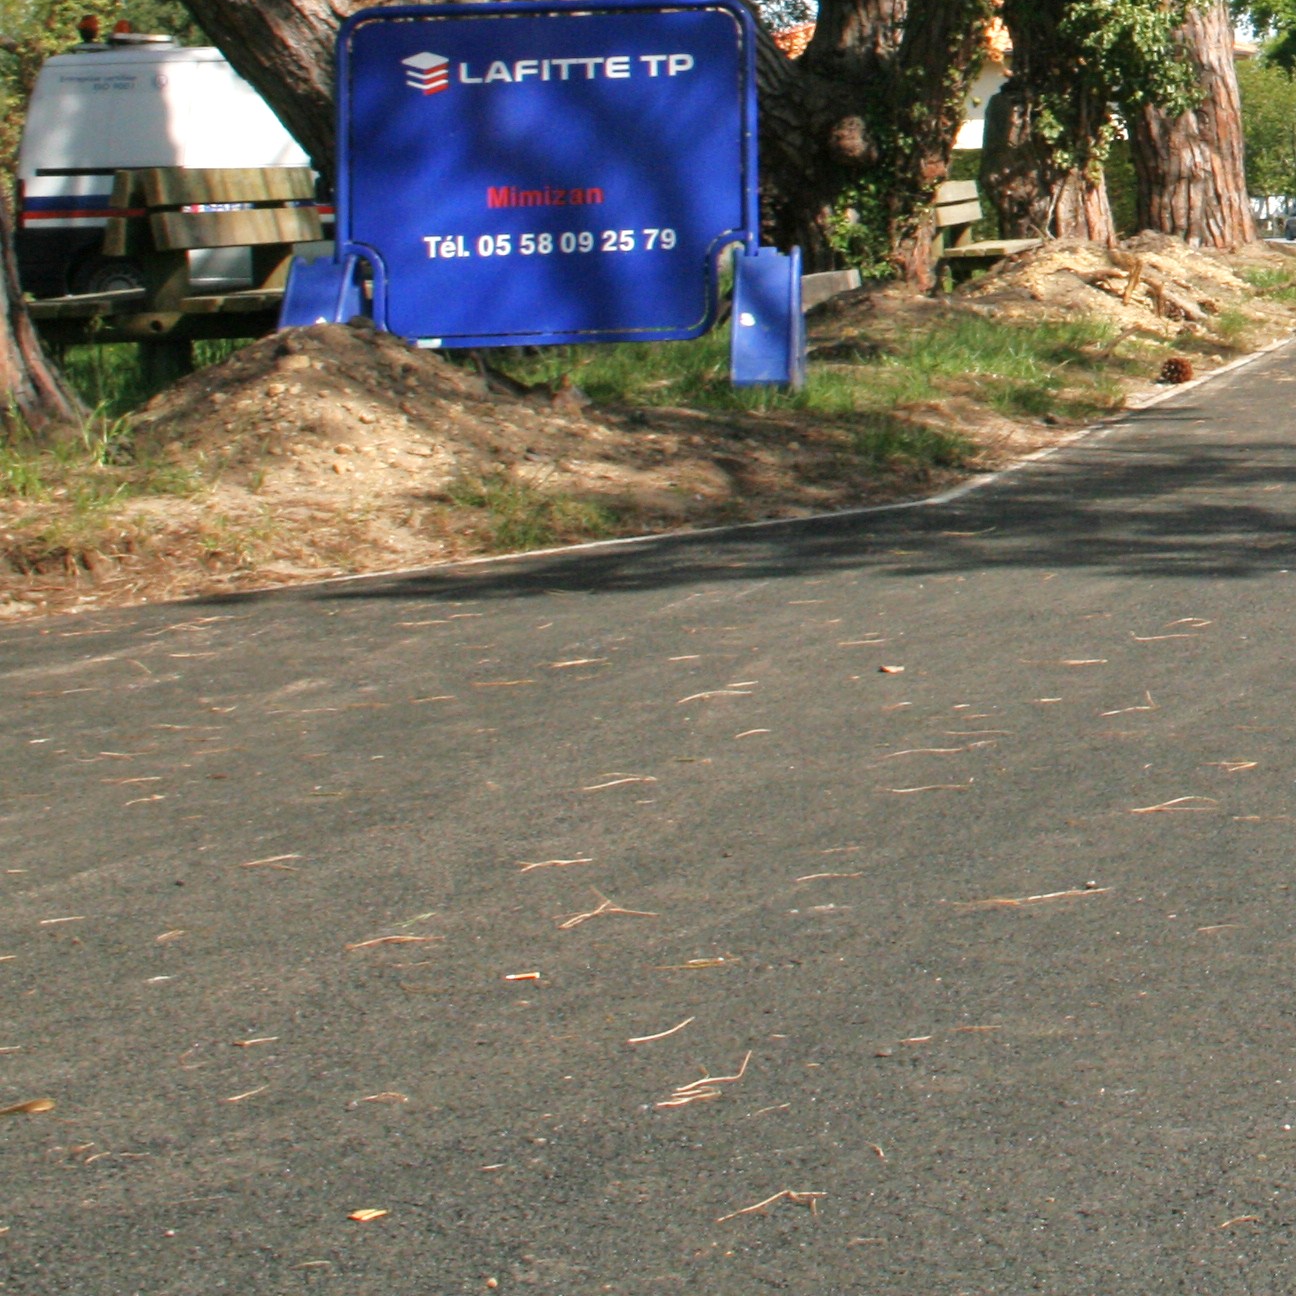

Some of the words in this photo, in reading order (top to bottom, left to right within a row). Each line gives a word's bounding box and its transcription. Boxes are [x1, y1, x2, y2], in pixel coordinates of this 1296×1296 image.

[459, 55, 631, 84] LAFITTE
[640, 53, 695, 77] TP
[487, 185, 604, 208] Mimizan
[424, 236, 470, 258] Tél.
[478, 234, 512, 256] 05
[519, 233, 554, 254] 58
[560, 231, 594, 253] 09
[601, 230, 635, 251] 25
[643, 228, 677, 250] 79
